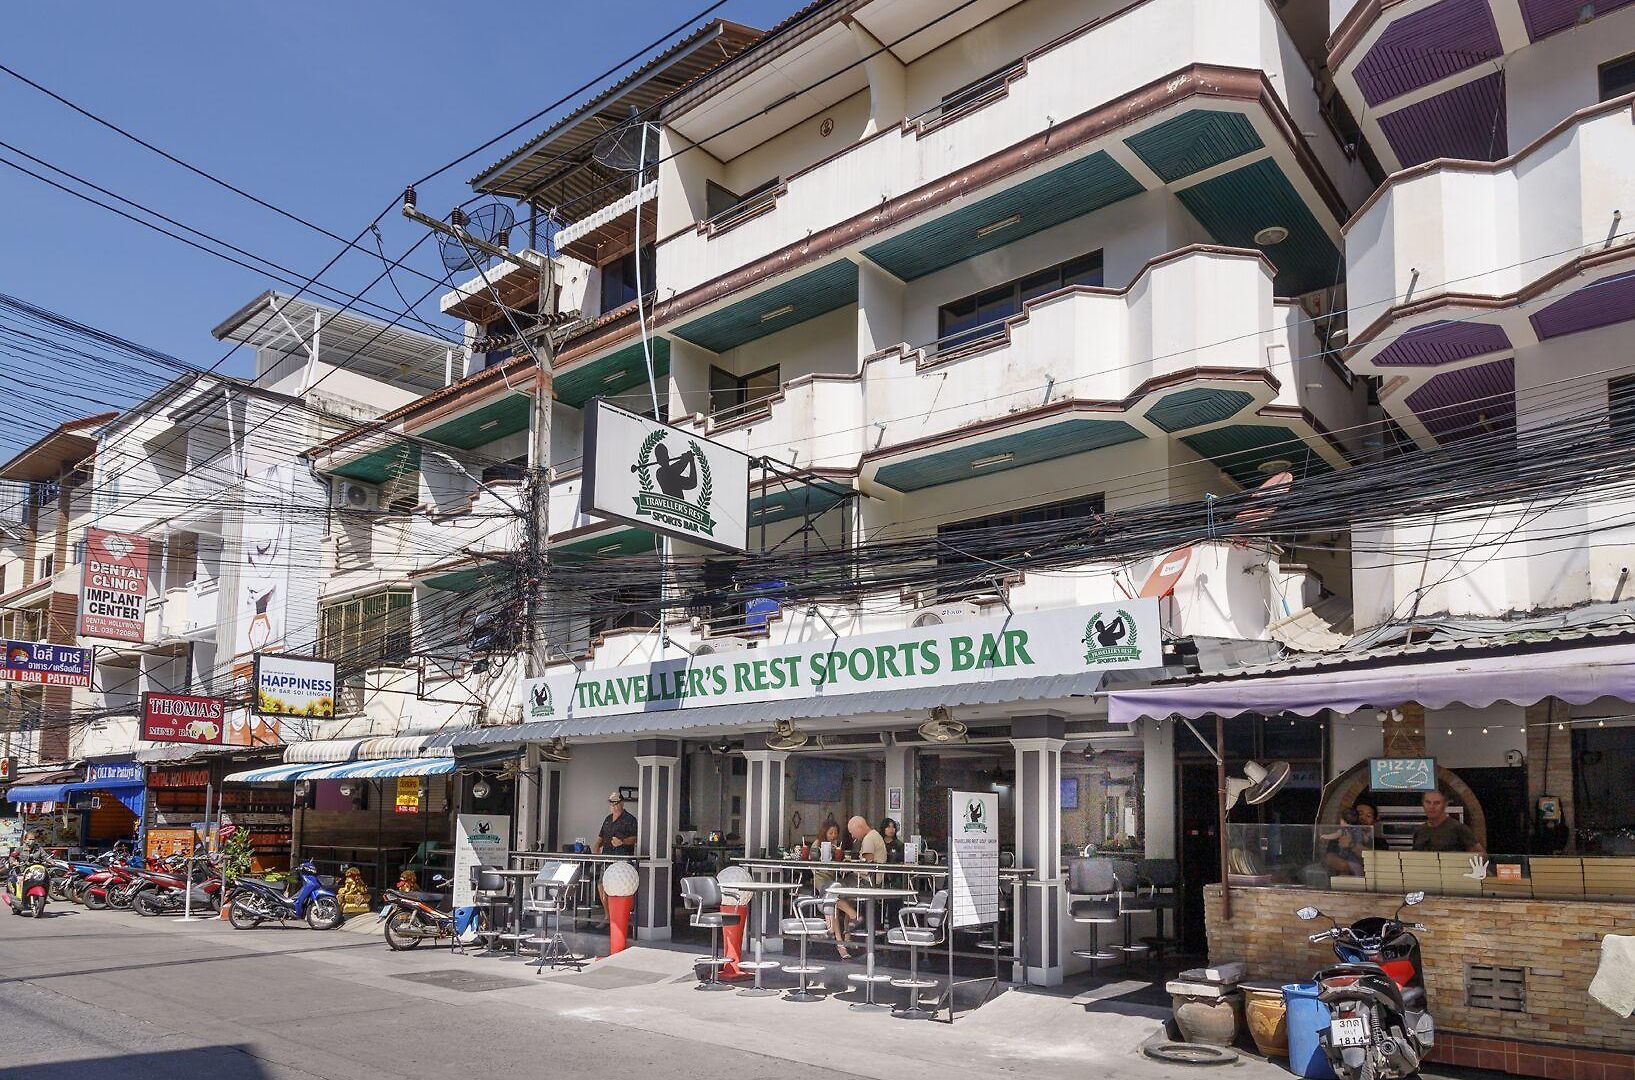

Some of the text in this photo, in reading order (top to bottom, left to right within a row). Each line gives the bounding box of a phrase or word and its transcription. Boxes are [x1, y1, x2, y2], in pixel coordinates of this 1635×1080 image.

[645, 497, 704, 522] TRAVELLER'S REST
[652, 511, 700, 533] SPORTS BAR
[90, 560, 145, 580] DENTAL
[92, 574, 138, 592] CLINIC
[87, 588, 143, 608] IMPLANT
[89, 602, 140, 620] CENTER
[85, 616, 142, 631] DENTAL HOLLYWOOD
[0, 669, 88, 686] OLI BAR PATTAYA
[576, 629, 1036, 709] TRAVELLER'S REST SPORTS BAR
[261, 674, 332, 691] HAPPINESS
[149, 698, 221, 719] THOMAS
[178, 728, 198, 738] BAR
[1377, 759, 1429, 772] PIZZA
[1339, 1037, 1364, 1046] 1814
